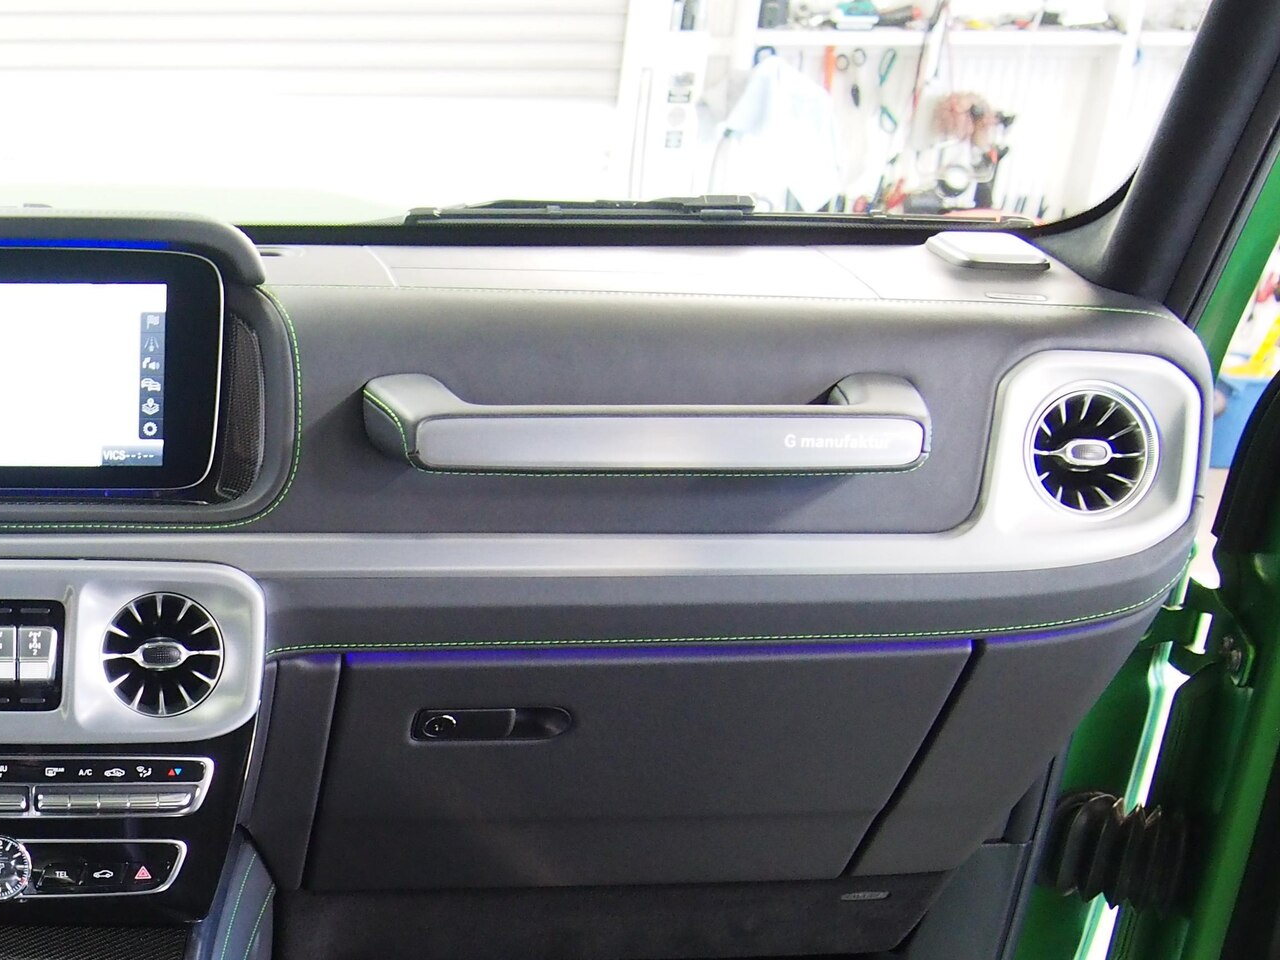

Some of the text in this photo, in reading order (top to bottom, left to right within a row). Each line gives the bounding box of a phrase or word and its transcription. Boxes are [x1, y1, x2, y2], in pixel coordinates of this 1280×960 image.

[784, 433, 890, 449] G manufaktur
[78, 768, 93, 776] A/C
